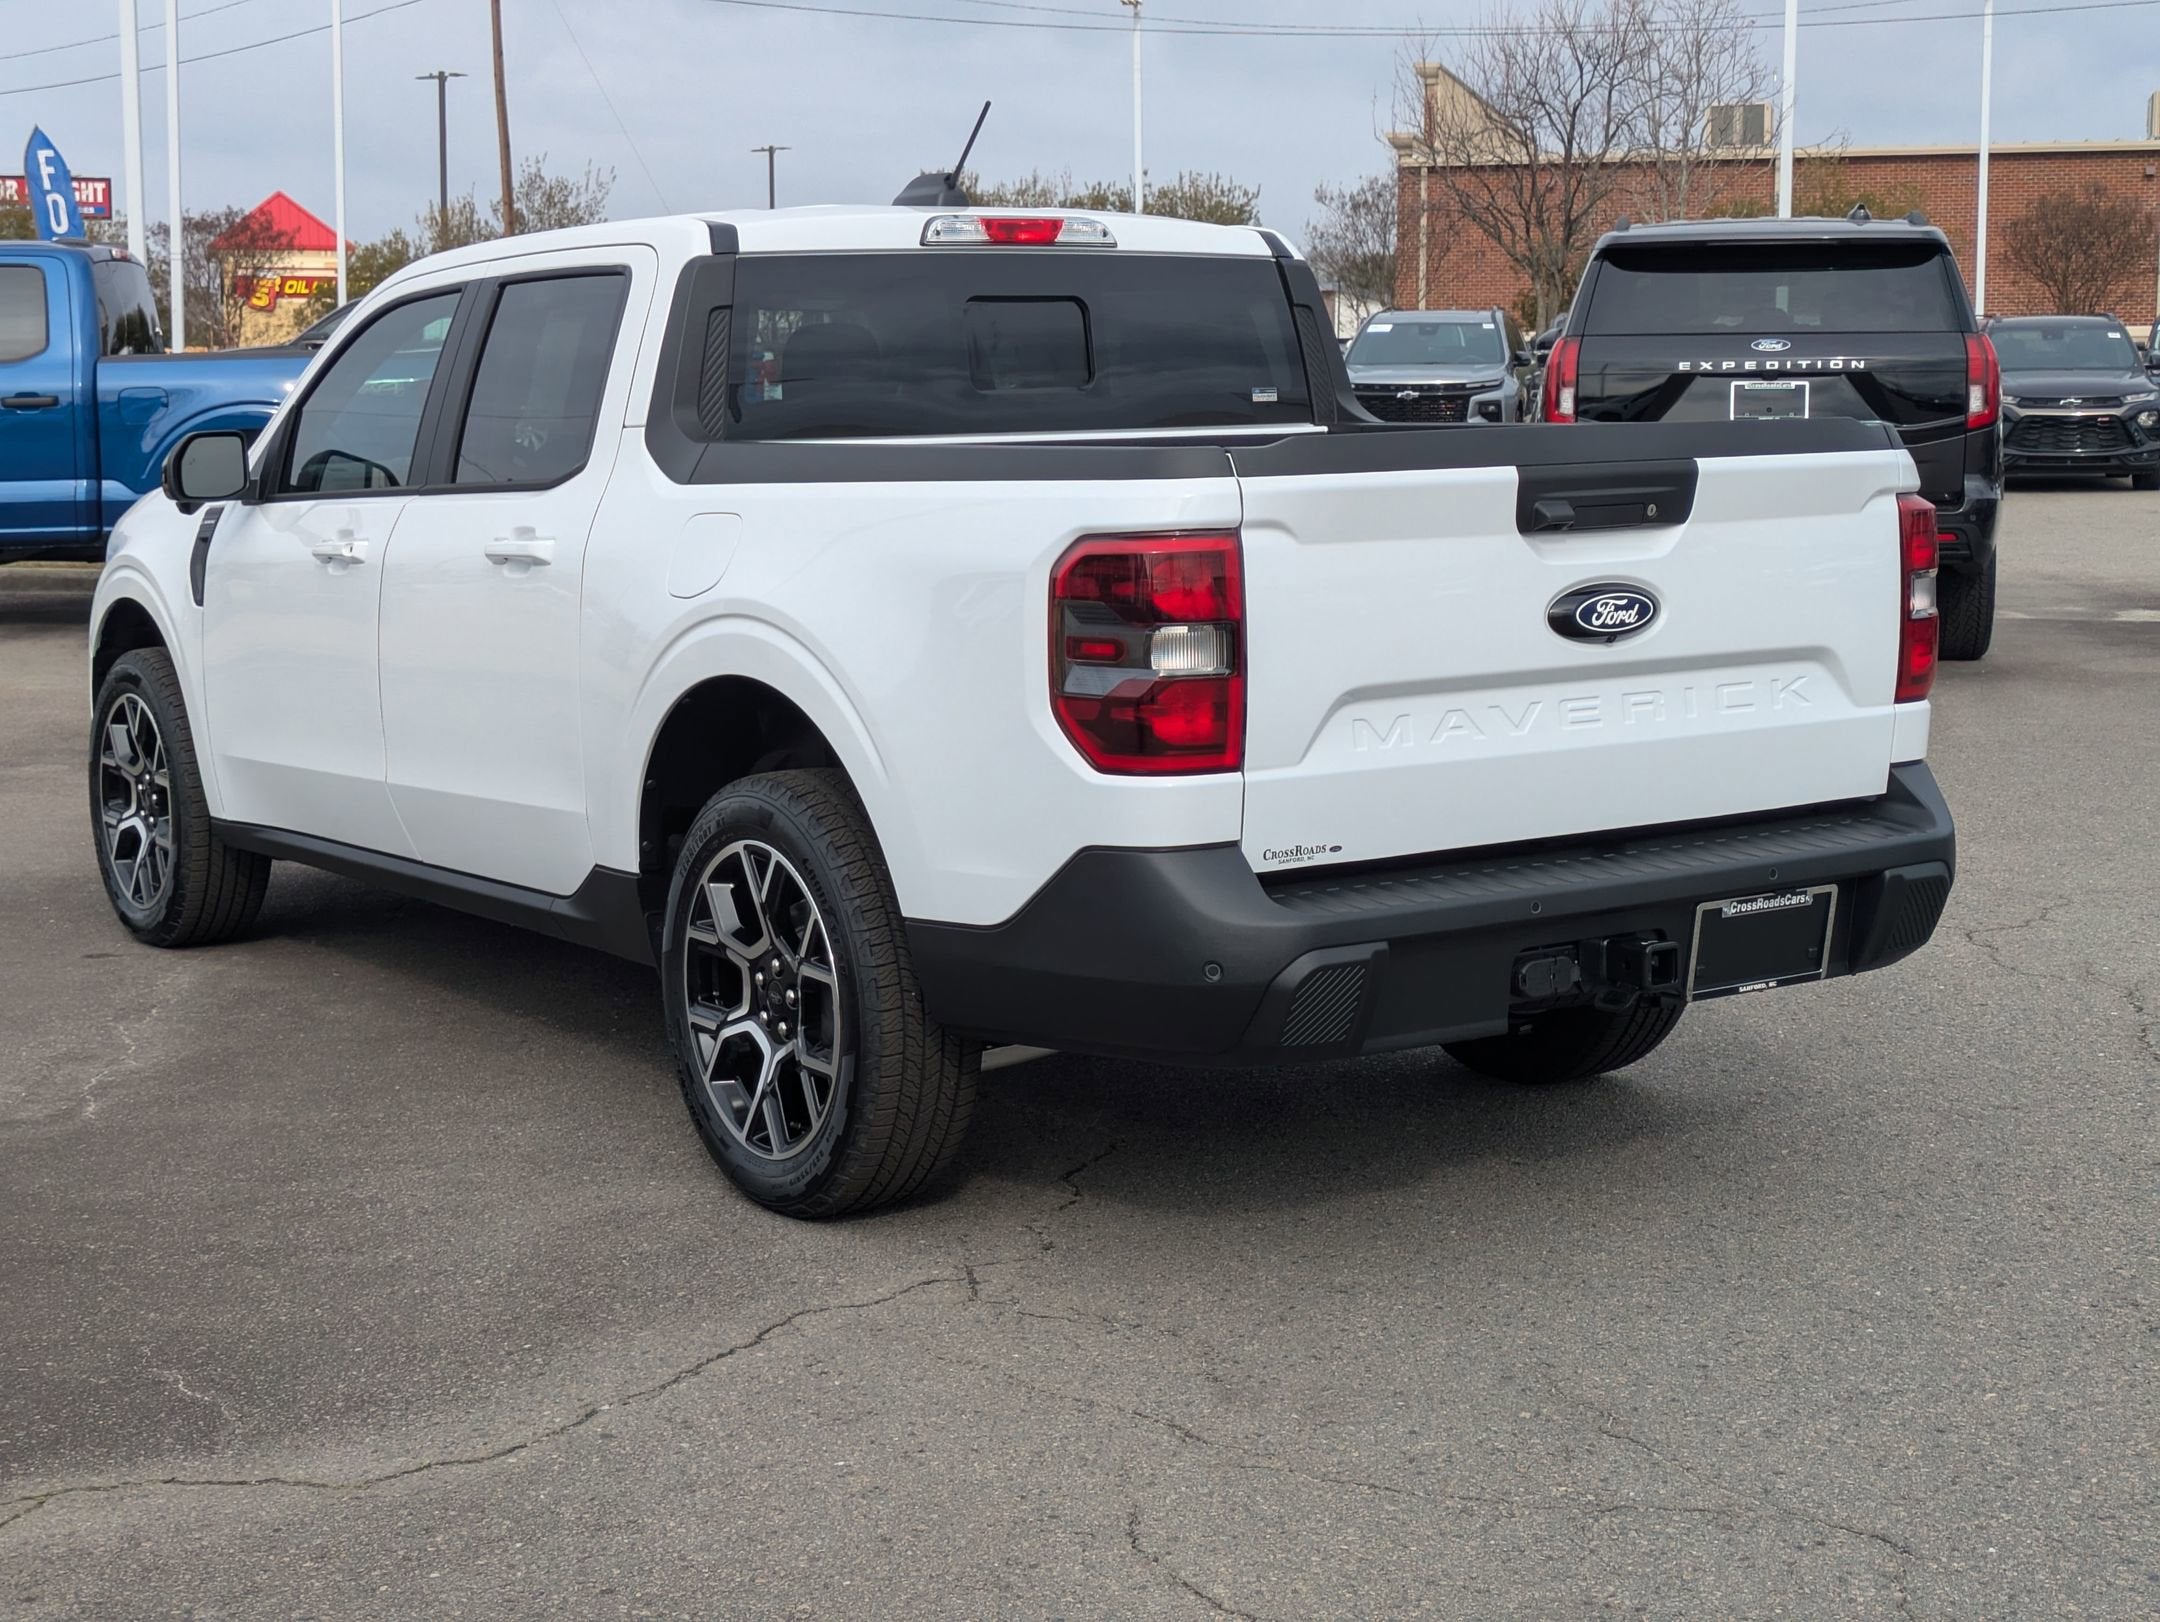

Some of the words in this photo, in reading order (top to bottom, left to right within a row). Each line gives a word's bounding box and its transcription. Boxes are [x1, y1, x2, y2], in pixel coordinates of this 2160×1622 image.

[36, 149, 69, 234] FO
[285, 280, 309, 294] OIL
[1758, 339, 1783, 350] Ford
[1679, 360, 1865, 370] EXPEDITION
[1592, 599, 1639, 626] Ford
[1351, 676, 1811, 753] MAVERICK
[1730, 894, 1805, 913] CrossRoadsCars
